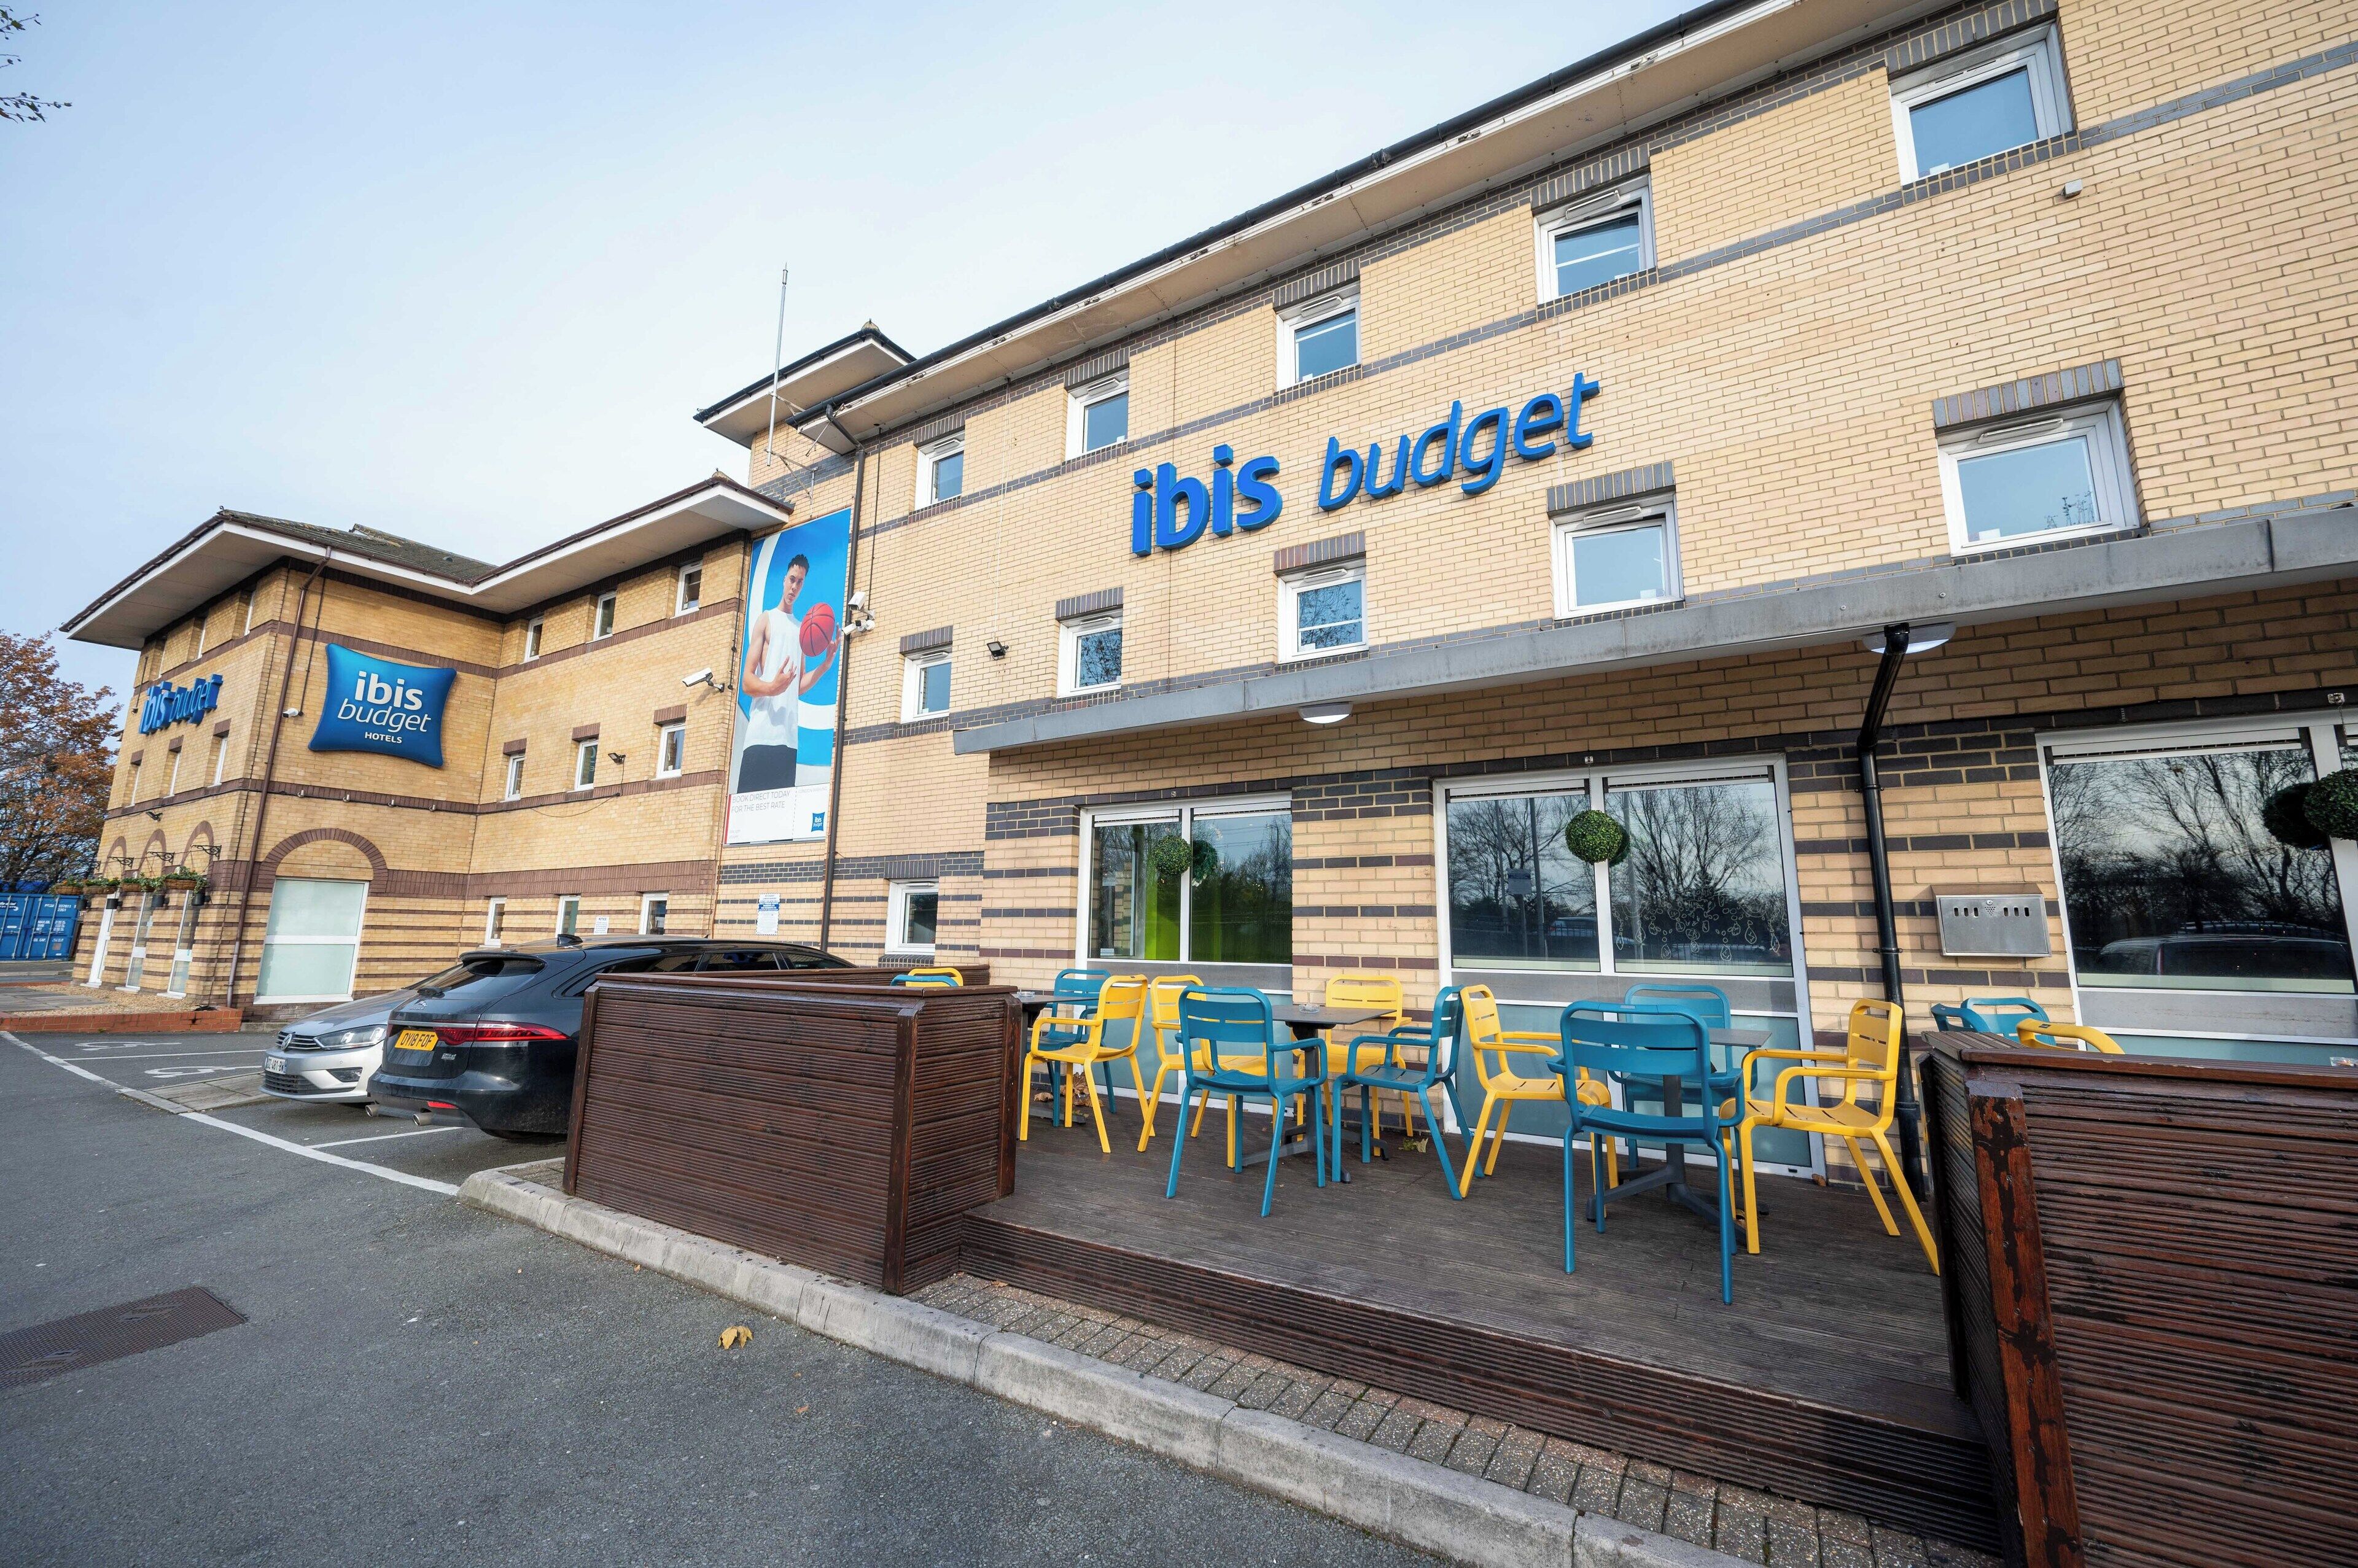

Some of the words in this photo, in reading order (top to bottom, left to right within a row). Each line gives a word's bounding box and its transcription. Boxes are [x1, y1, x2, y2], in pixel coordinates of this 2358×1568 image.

[1132, 443, 1283, 557] ibis
[1317, 371, 1601, 512] budget
[354, 670, 423, 711] ibis
[139, 680, 174, 734] ibis
[169, 673, 224, 724] budget
[337, 698, 432, 733] budget
[365, 731, 402, 744] HOTELS
[732, 794, 749, 803] BOOK
[749, 792, 770, 801] DIRECT
[771, 790, 790, 799] TODAY
[756, 802, 770, 811] BEST
[400, 1032, 419, 1046] OY18
[416, 1034, 435, 1048] FOF
